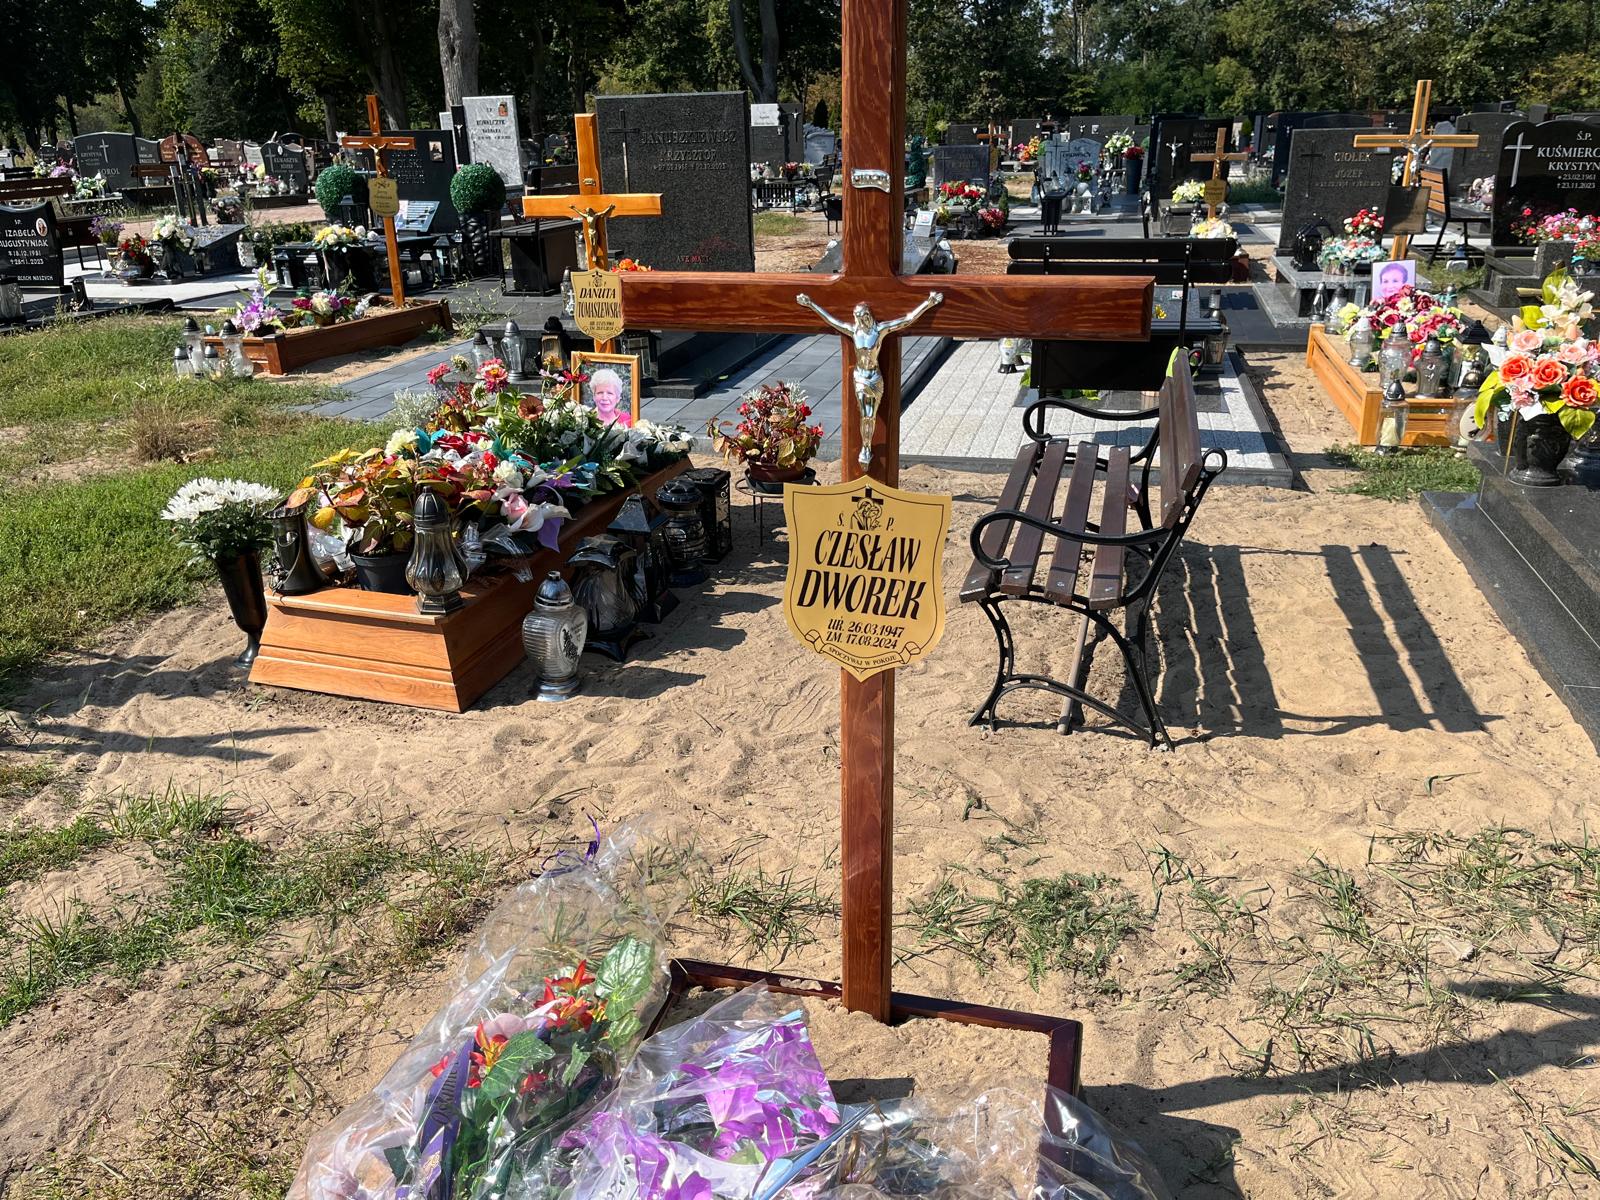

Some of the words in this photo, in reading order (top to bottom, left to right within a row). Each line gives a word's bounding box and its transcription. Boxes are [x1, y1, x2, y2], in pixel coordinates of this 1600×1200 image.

[5, 229, 37, 238] IZABELA
[579, 287, 616, 299] DANUTA
[814, 530, 921, 575] CZESŁAW
[797, 569, 927, 621] DWOREK
[848, 621, 905, 638] 26.03.1947
[826, 631, 843, 644] ZM.
[846, 634, 898, 650] 17.08.2024
[829, 646, 863, 666] SPOCZYWAJ
[873, 656, 897, 666] POKOJU
